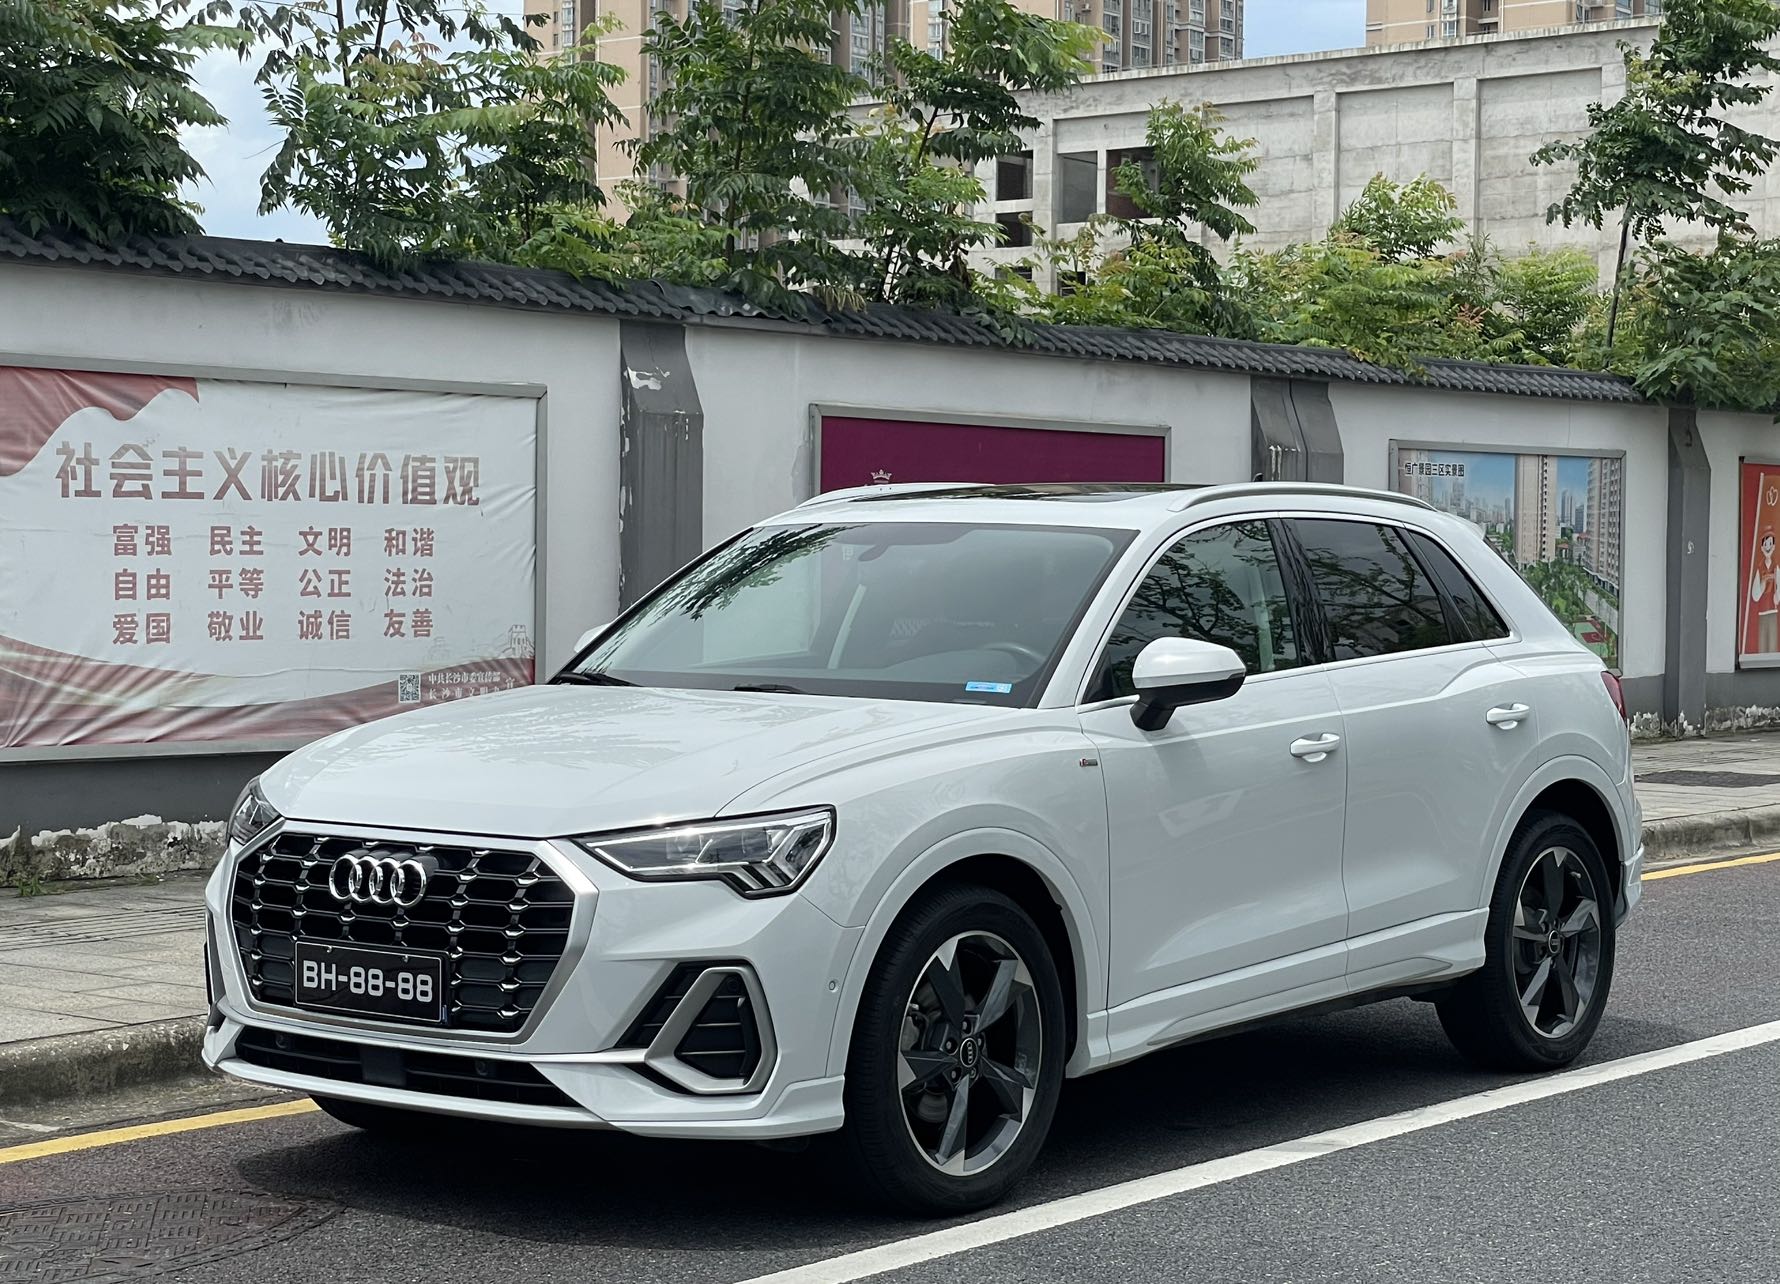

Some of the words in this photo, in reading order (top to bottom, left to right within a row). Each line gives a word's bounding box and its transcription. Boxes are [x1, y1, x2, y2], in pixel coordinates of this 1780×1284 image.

[55, 441, 480, 505] 社会主义核心价值观
[112, 523, 172, 556] 富强
[209, 525, 264, 556] 民主
[298, 525, 351, 557] 文明
[384, 527, 435, 557] 和谐
[114, 568, 171, 601] 自由
[208, 567, 264, 600] 平等
[298, 568, 351, 598] 公正
[384, 568, 434, 597] 法治
[112, 612, 171, 644] 爱国
[207, 610, 264, 641] 敬业
[298, 609, 351, 641] 诚信
[383, 608, 434, 638] 友善
[428, 671, 501, 685] 中共长沙市委宣传部
[303, 960, 433, 1003] BH-88-88
